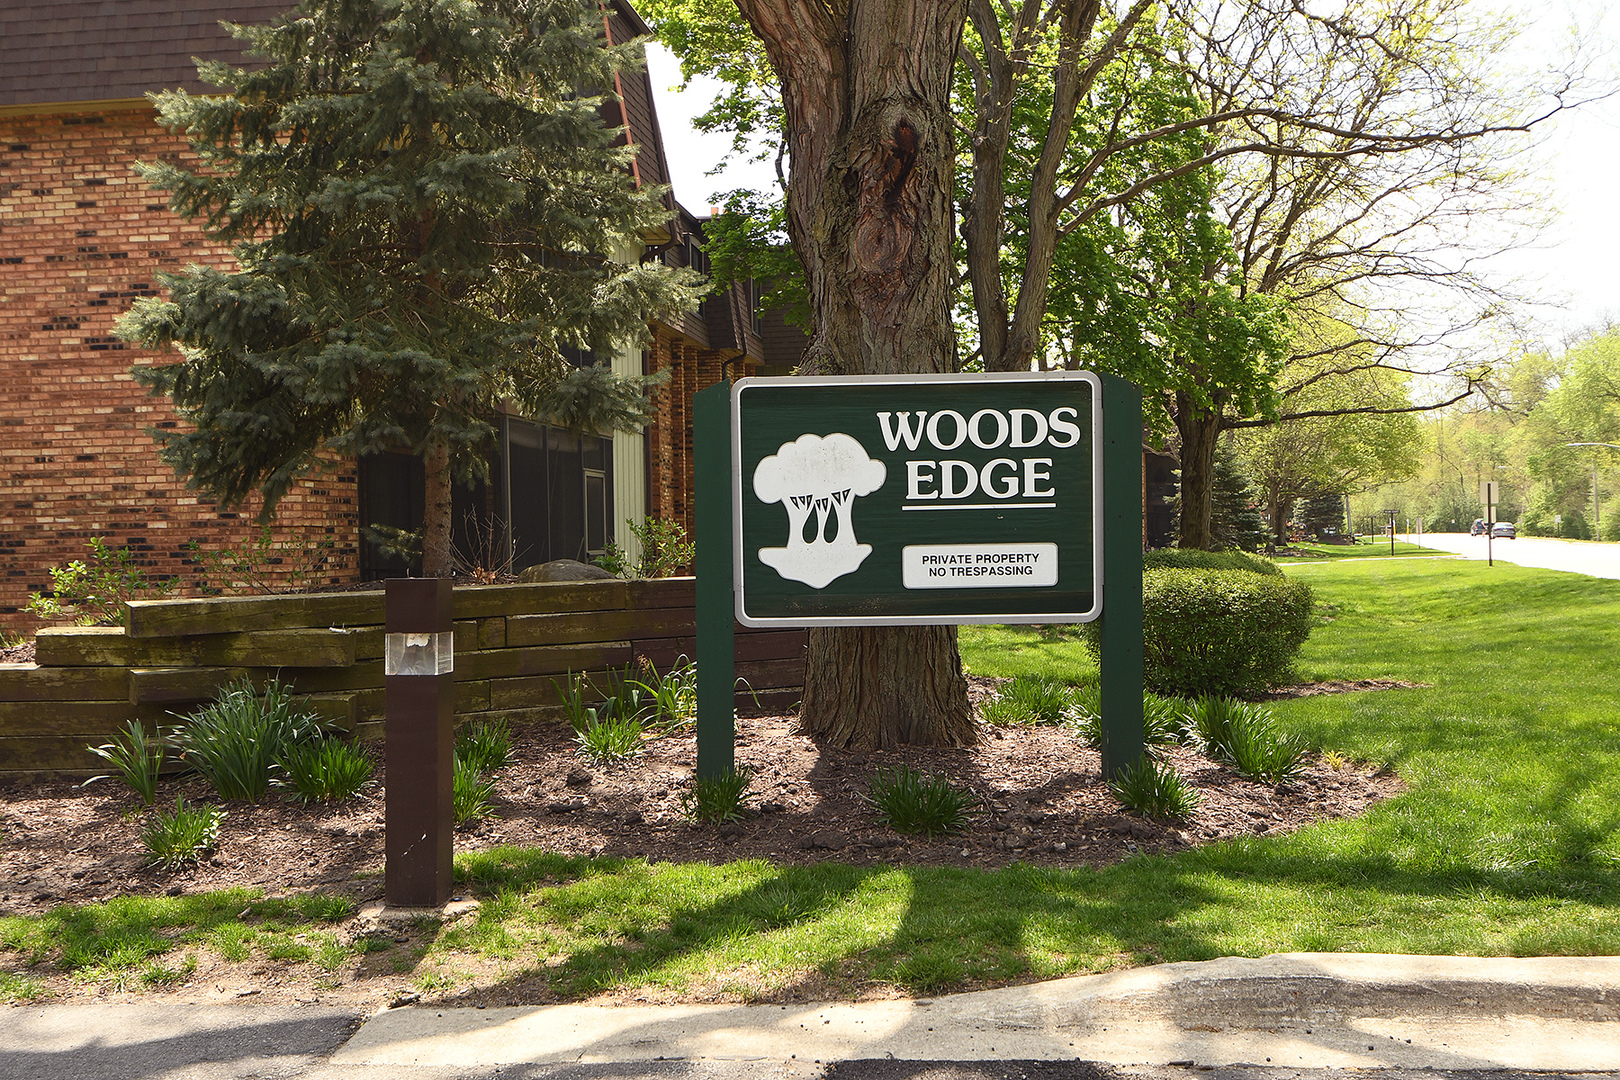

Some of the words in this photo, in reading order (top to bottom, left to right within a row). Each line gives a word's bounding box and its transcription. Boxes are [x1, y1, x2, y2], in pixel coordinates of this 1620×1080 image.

[876, 407, 1081, 451] WOODS
[905, 458, 1055, 499] EDGE
[922, 554, 972, 565] PRIVATE
[975, 553, 1039, 564] PROPERTY
[929, 567, 947, 577] NO
[950, 565, 1033, 576] TRESPASSING
